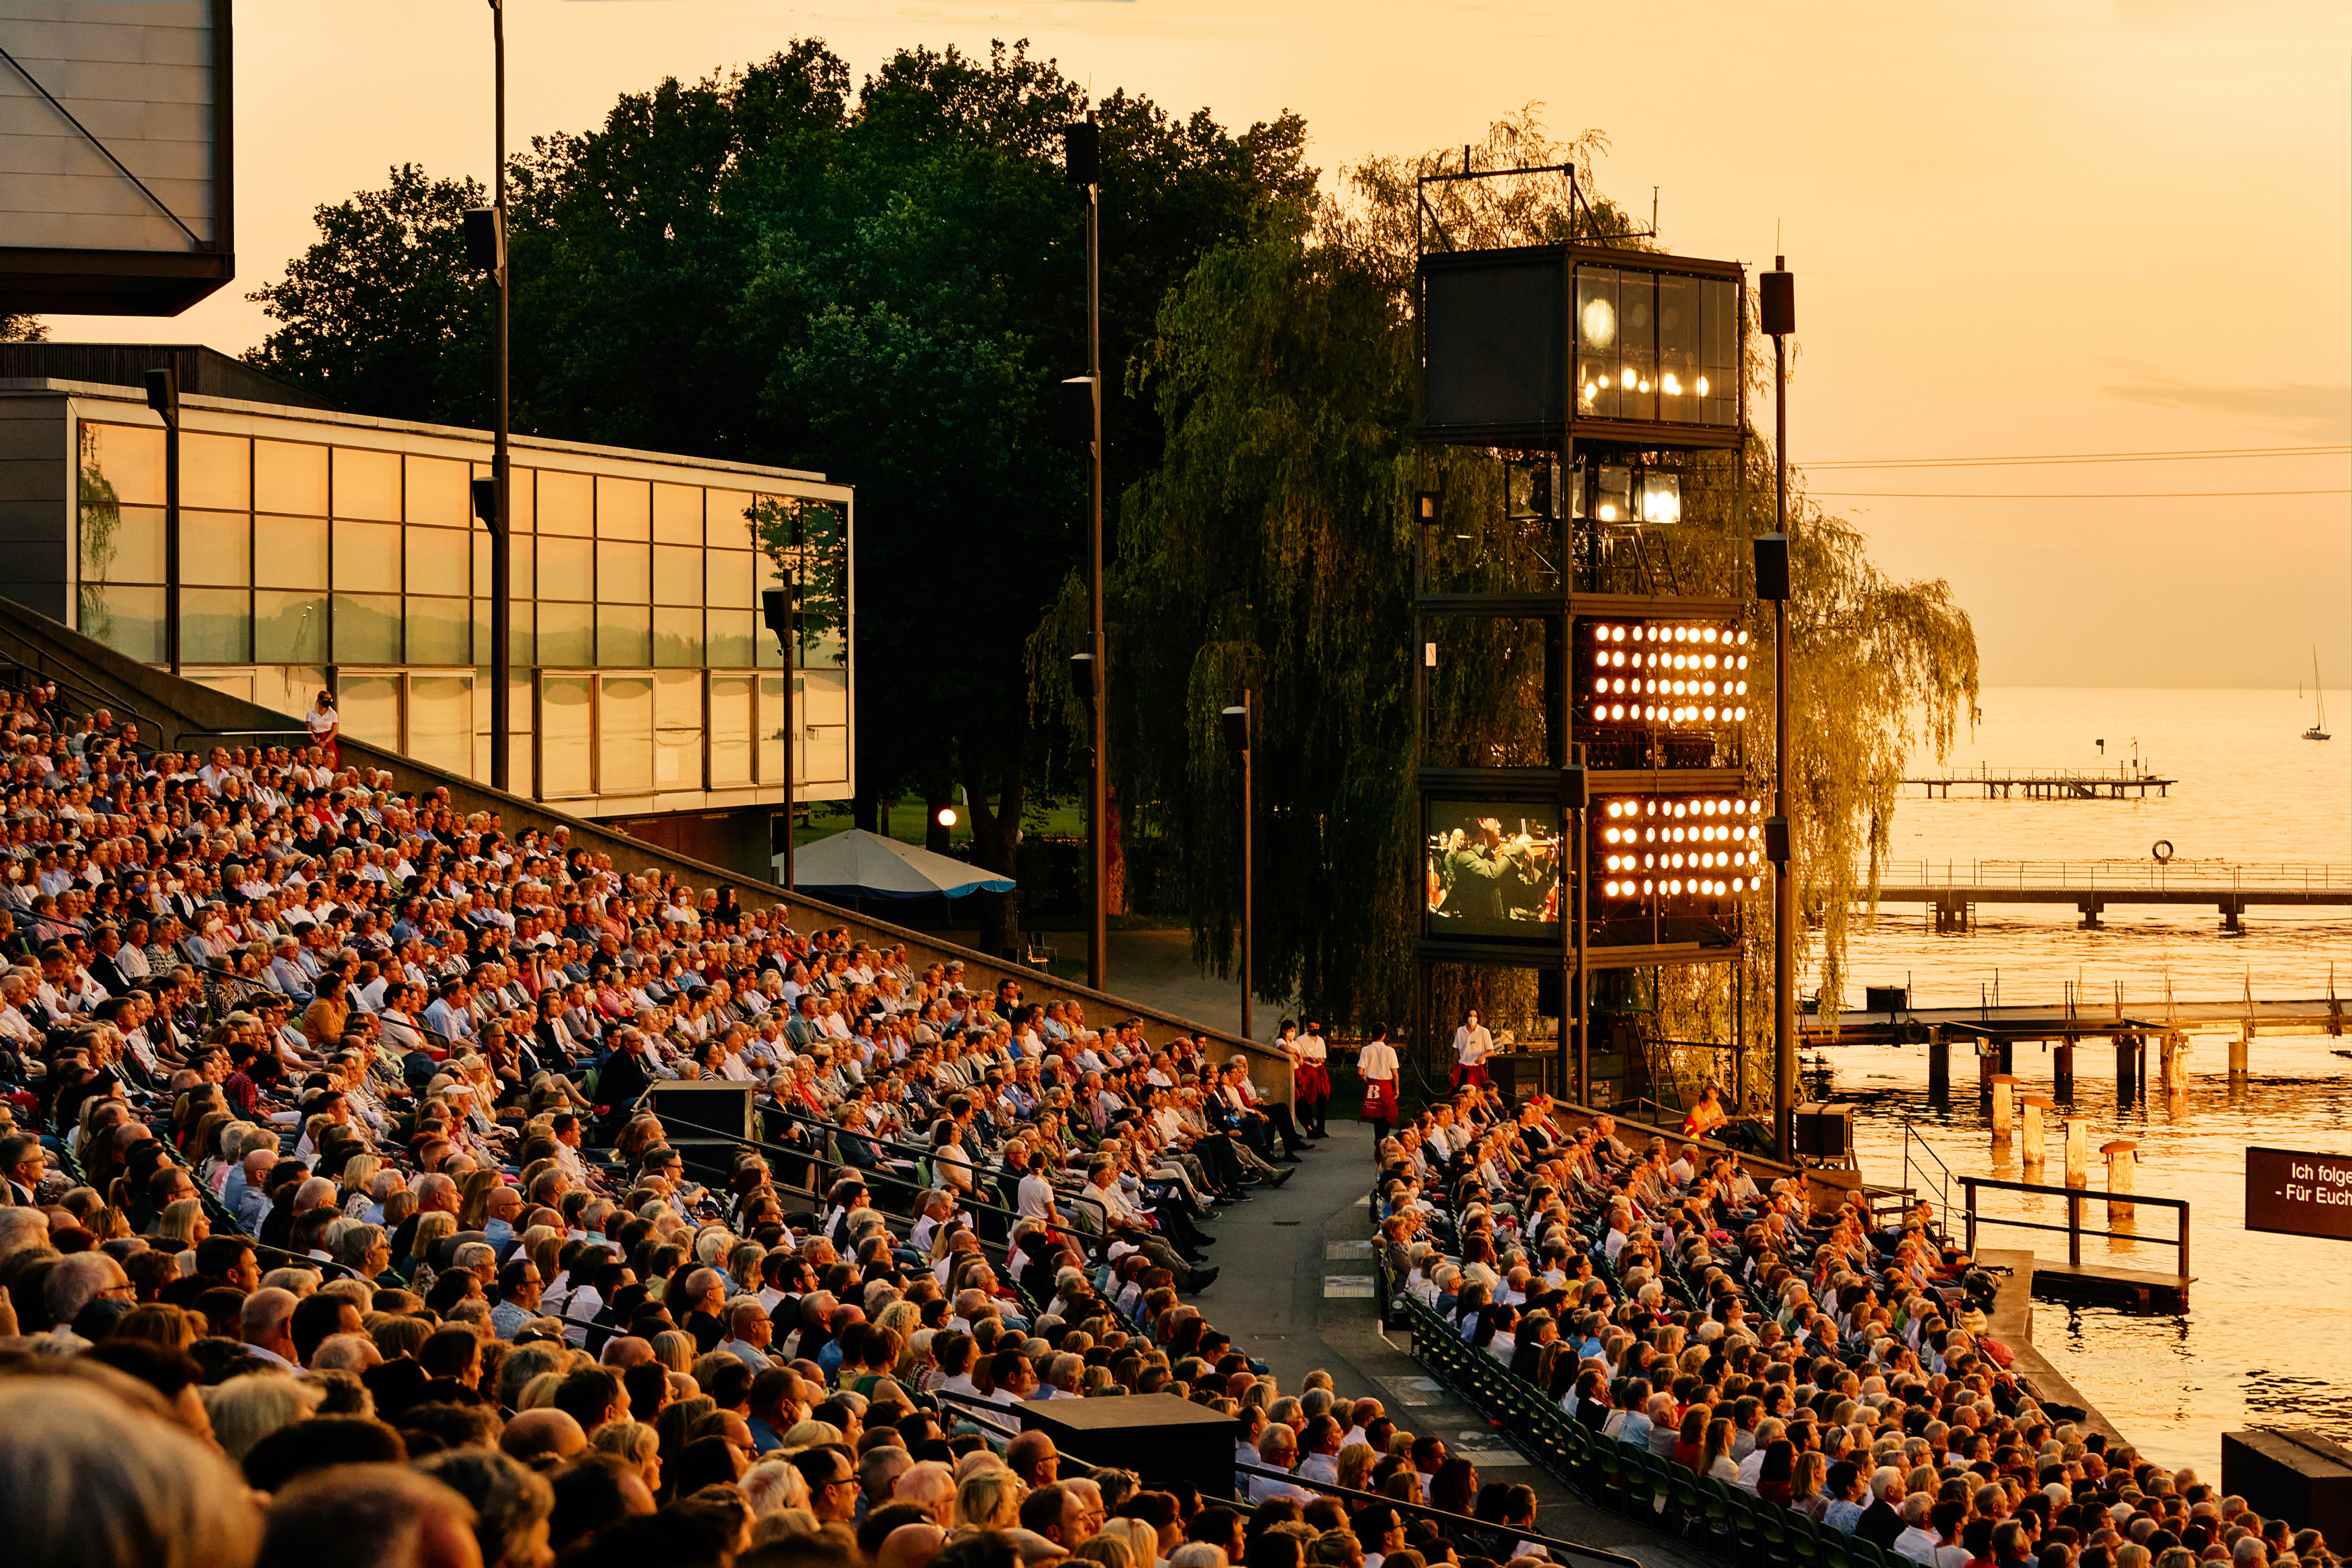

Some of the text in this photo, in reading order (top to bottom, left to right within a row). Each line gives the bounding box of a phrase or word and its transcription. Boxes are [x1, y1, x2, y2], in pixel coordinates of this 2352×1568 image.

[1367, 1085, 1380, 1098] B
[2292, 1162, 2352, 1187] Ich folge
[2286, 1183, 2312, 1202] Für
[2316, 1187, 2352, 1206] Euch
